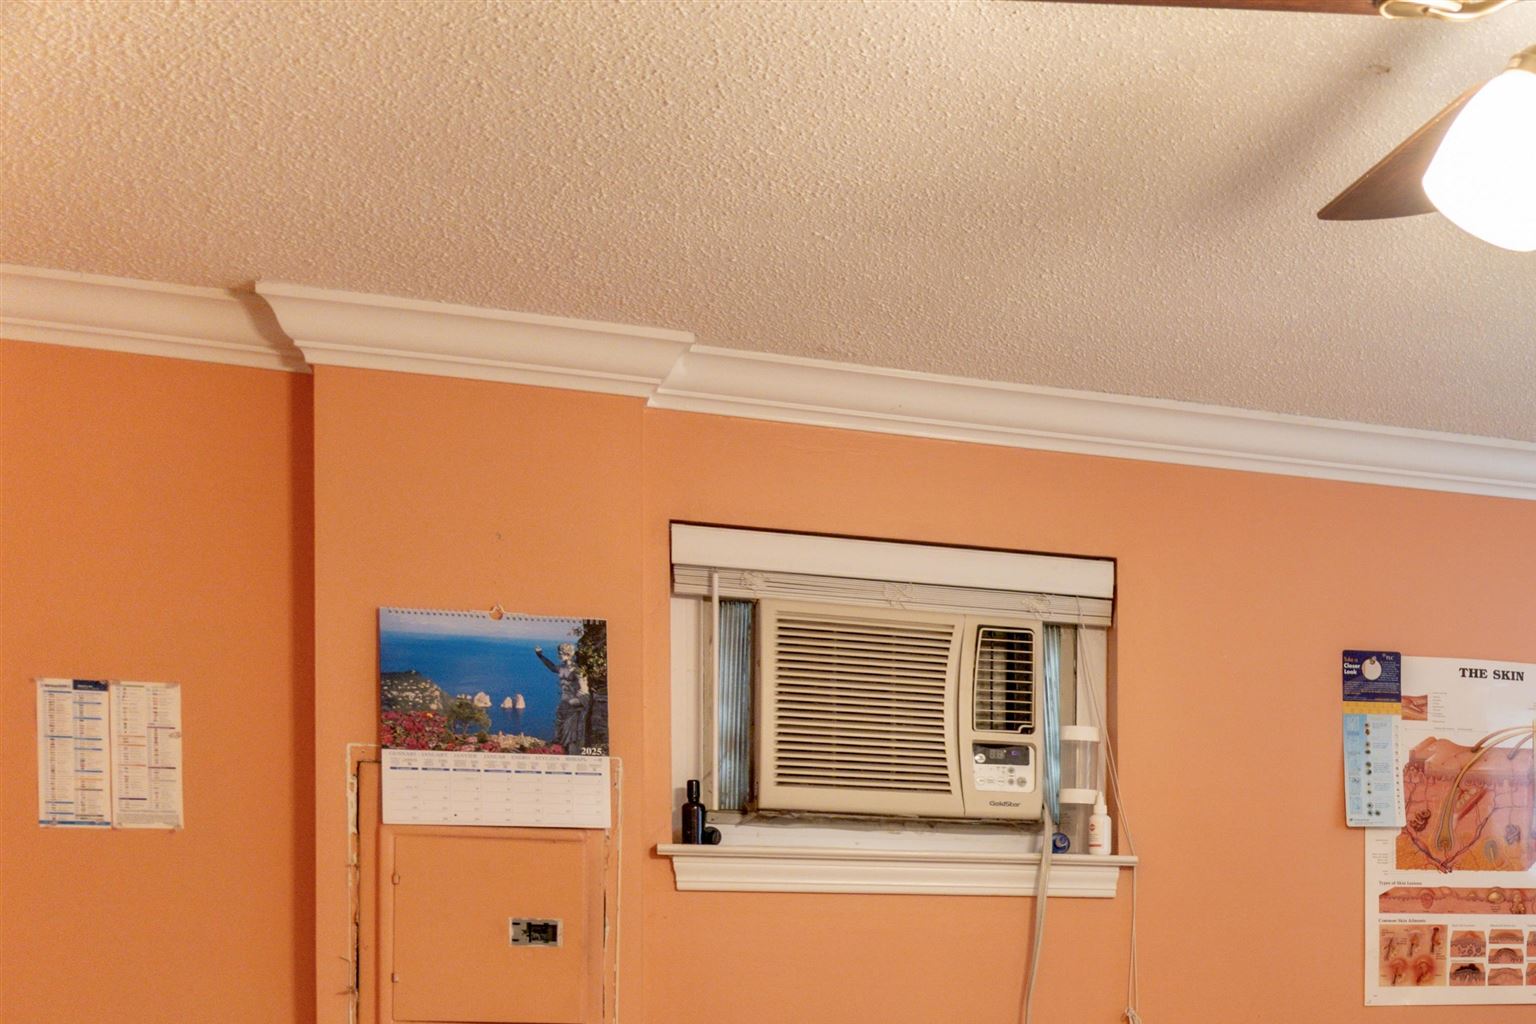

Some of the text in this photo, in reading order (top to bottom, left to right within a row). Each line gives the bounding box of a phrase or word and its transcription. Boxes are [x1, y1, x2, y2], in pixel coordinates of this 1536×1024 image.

[1459, 667, 1525, 682] THE SKIN
[581, 747, 602, 756] 2025
[989, 800, 1020, 808] GoldStar
